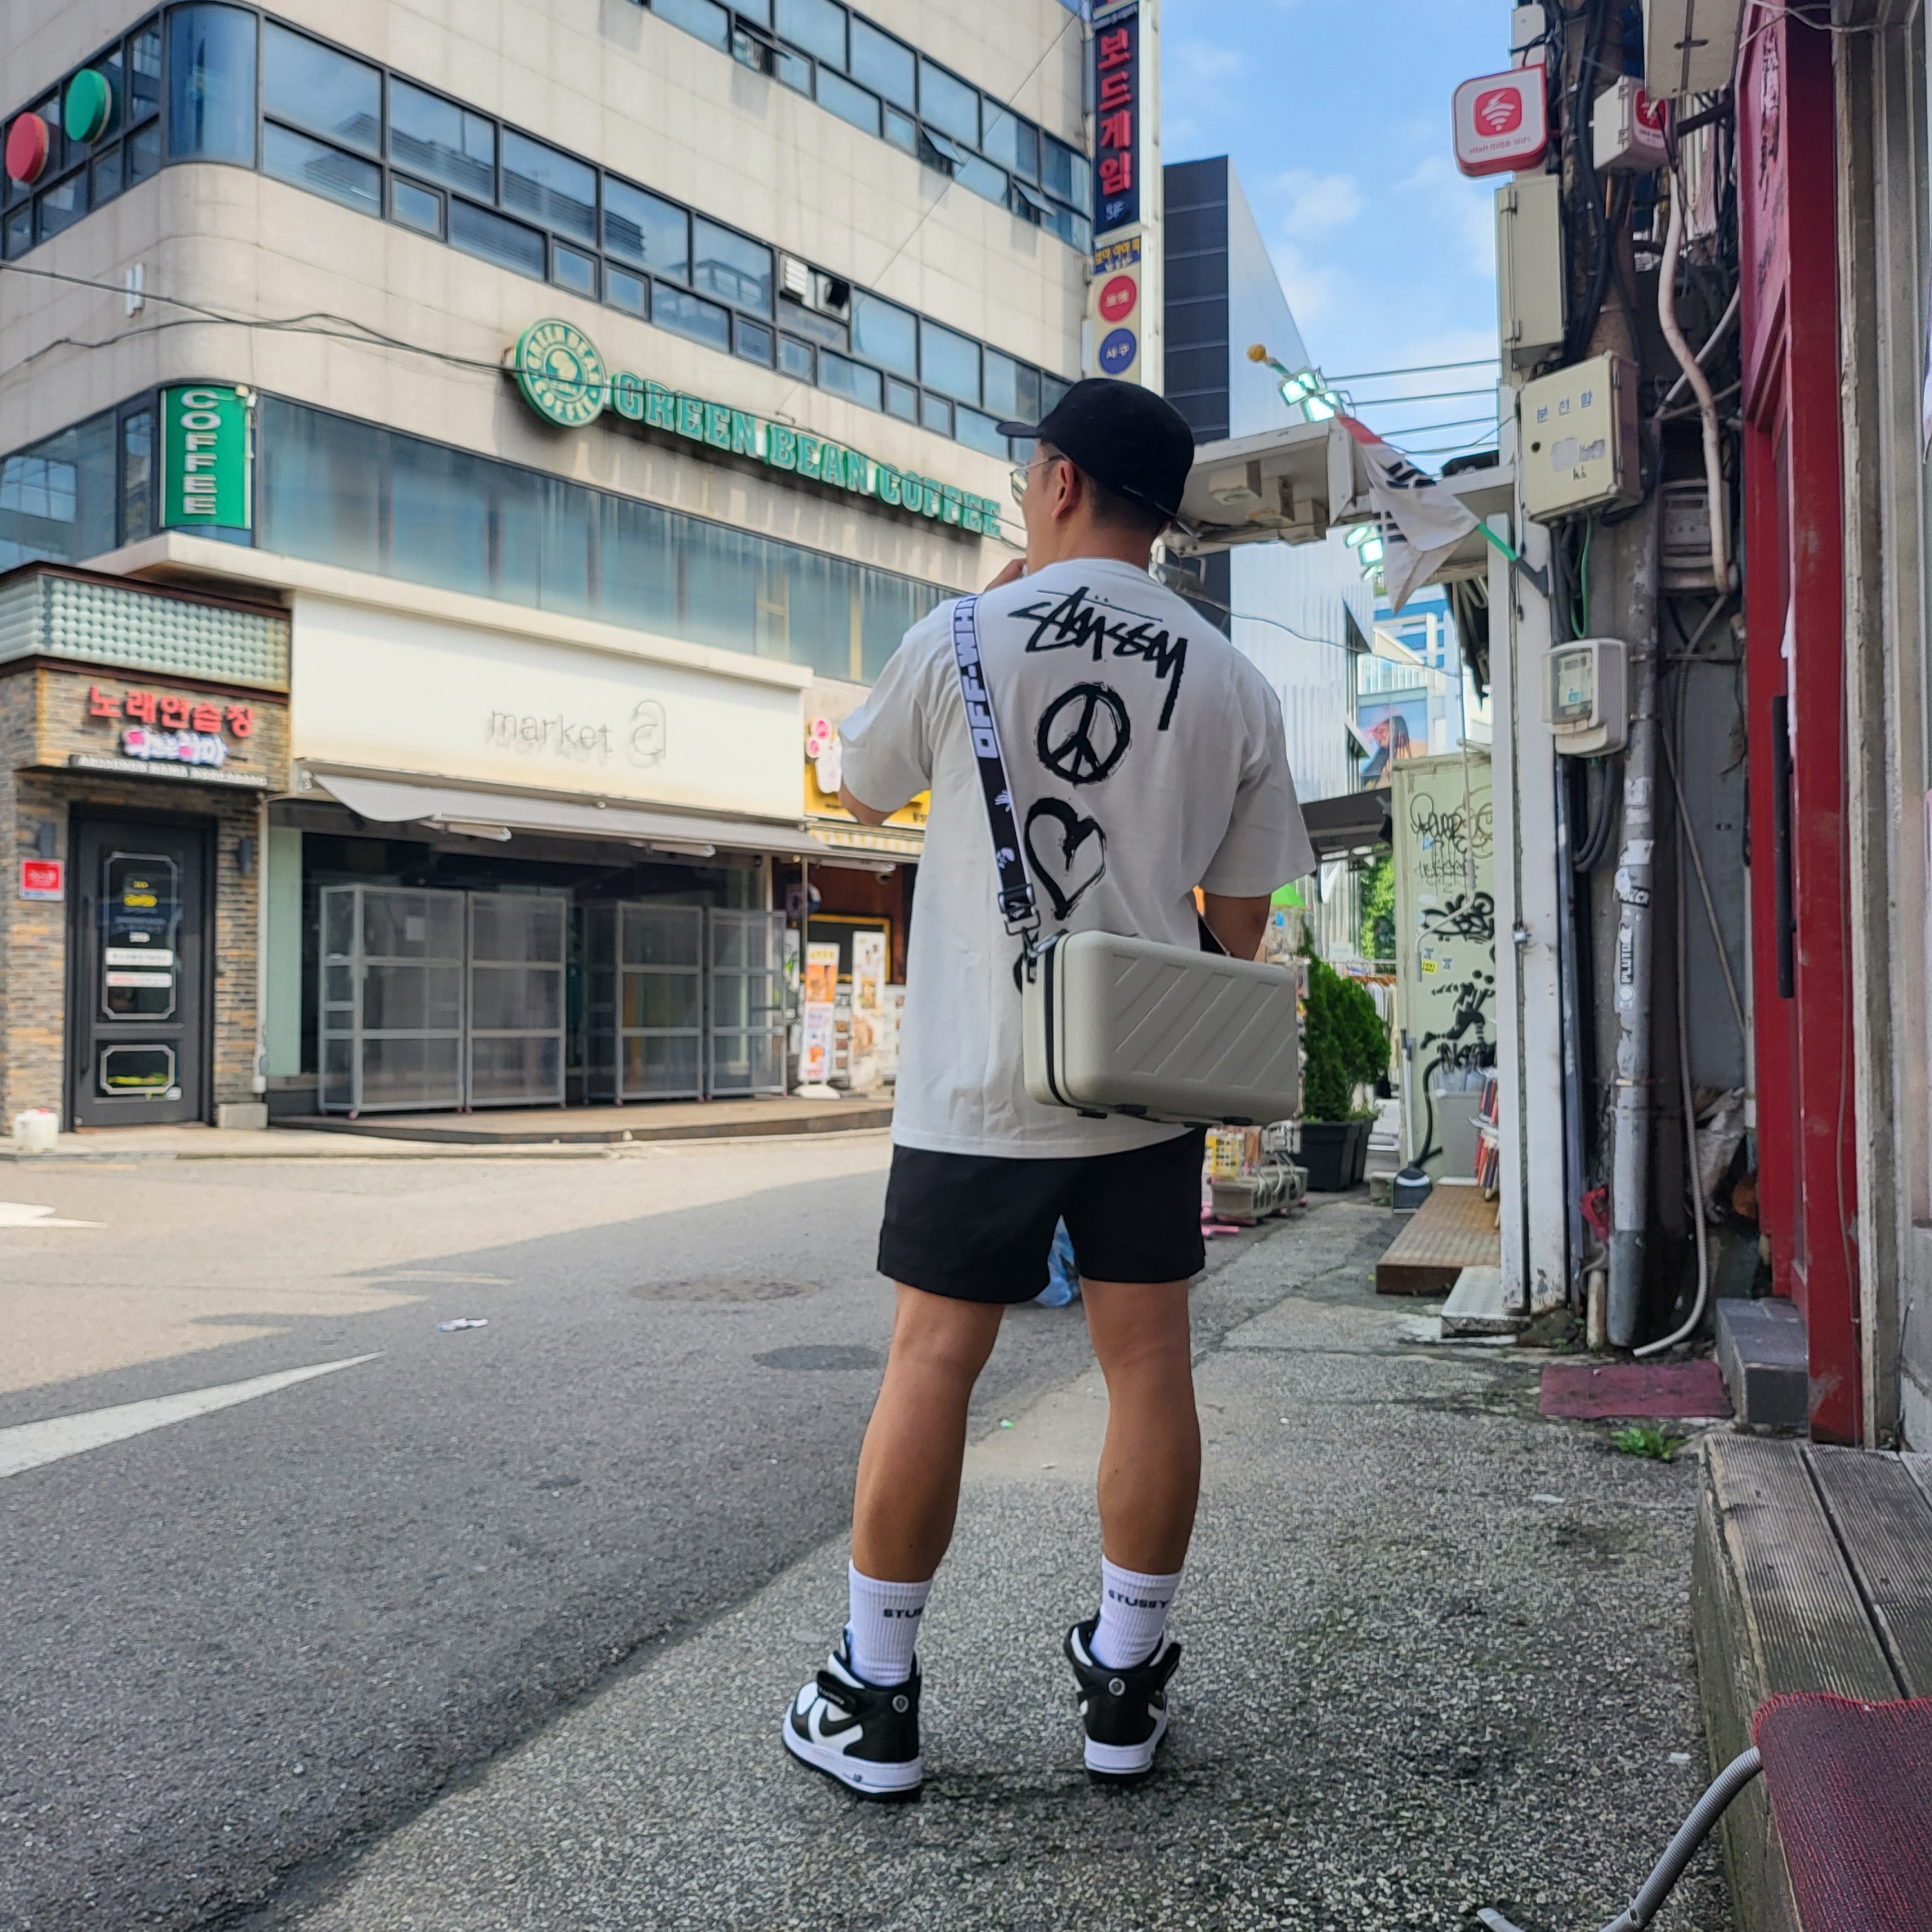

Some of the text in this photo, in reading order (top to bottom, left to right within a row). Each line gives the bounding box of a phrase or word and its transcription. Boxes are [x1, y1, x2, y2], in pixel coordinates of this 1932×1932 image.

[1097, 27, 1132, 196] 보드게임
[180, 389, 223, 516] COFFEE
[612, 371, 1003, 540] GREEN BEAN COFFEE
[89, 684, 256, 738] 노래연습장
[488, 710, 614, 755] market
[1108, 1589, 1171, 1609] STUSSY
